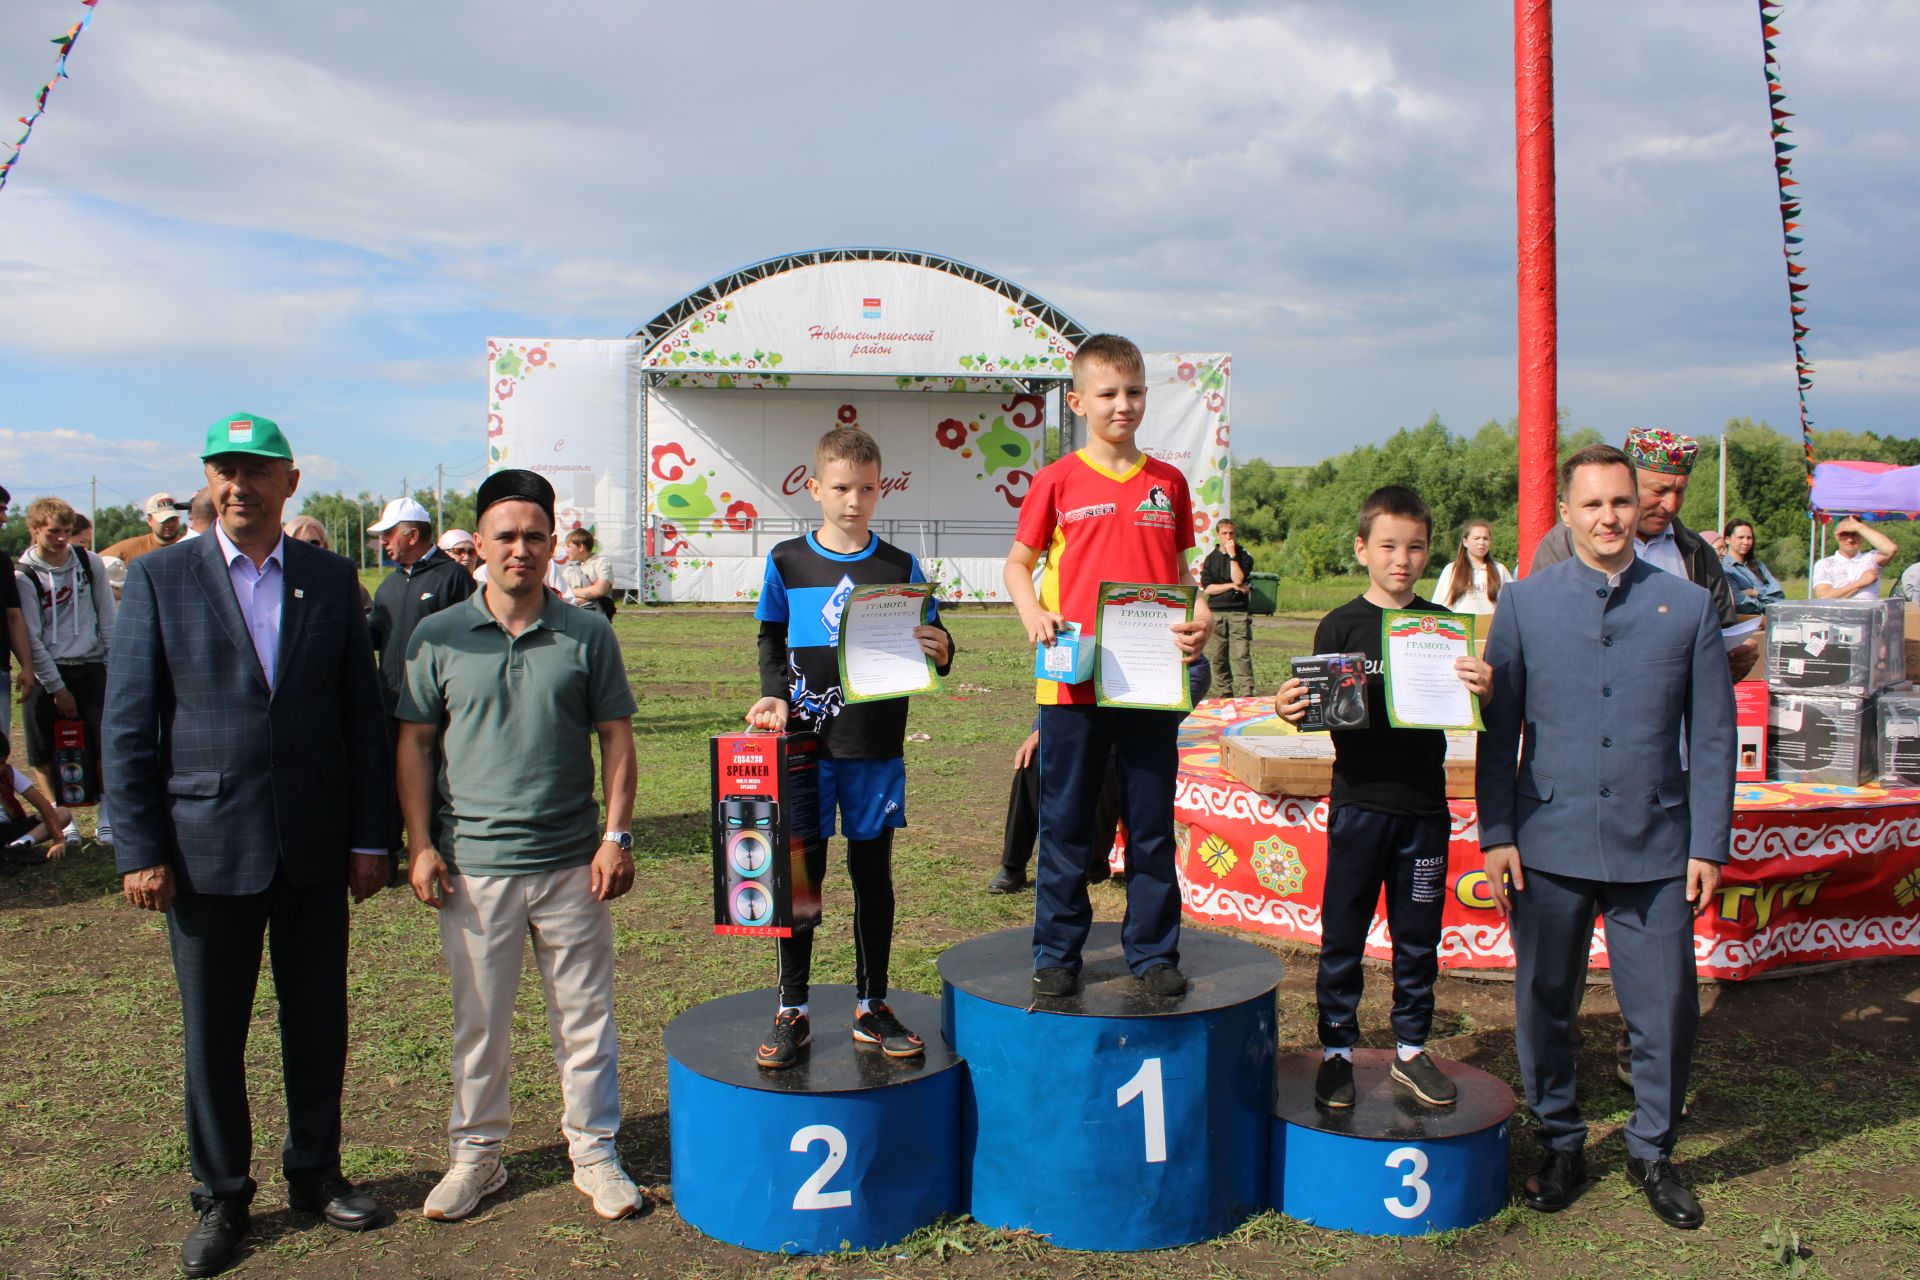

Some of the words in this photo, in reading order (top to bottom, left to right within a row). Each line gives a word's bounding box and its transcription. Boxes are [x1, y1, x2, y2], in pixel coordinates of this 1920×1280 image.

[808, 325, 936, 342] Новошешминский
[850, 342, 893, 358] район
[865, 600, 907, 610] ГРАМОТА
[1121, 609, 1168, 619] ГРАМОТА
[1406, 641, 1450, 651] ГРАМОТА
[726, 765, 769, 776] SPEAKER
[1116, 1057, 1167, 1164] 1
[789, 1124, 853, 1211] 2
[1383, 1147, 1431, 1220] 3
